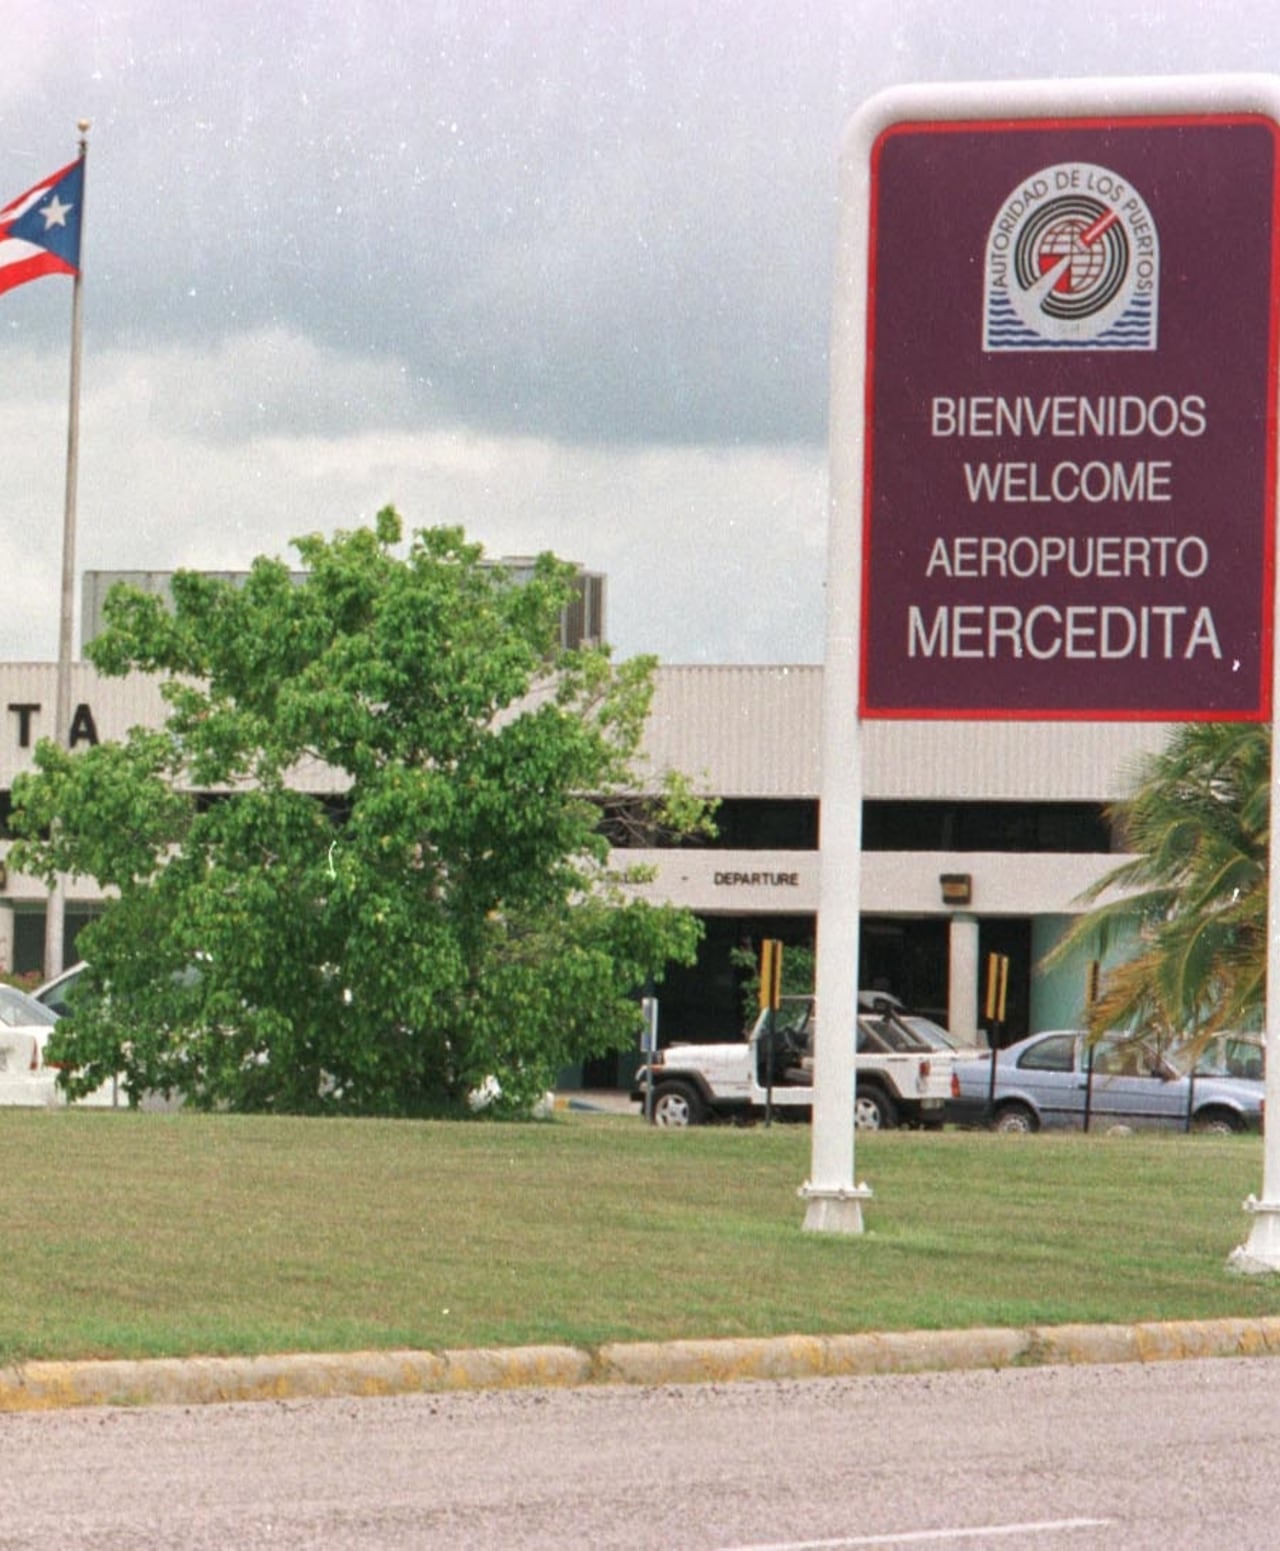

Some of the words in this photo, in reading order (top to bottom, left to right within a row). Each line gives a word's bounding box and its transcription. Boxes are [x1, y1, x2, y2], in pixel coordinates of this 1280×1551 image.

[991, 180, 1049, 289] AUTORIDAD
[1055, 169, 1080, 191] DE
[1087, 172, 1125, 202] LOS
[1121, 198, 1154, 290] PUERTOS
[930, 396, 1207, 437] BIENVENIDOS
[964, 462, 1172, 502] WELCOME
[926, 536, 1209, 578] AEROPUERTO
[907, 605, 1222, 659] MERCEDITA
[714, 872, 800, 886] DEPARTURE
